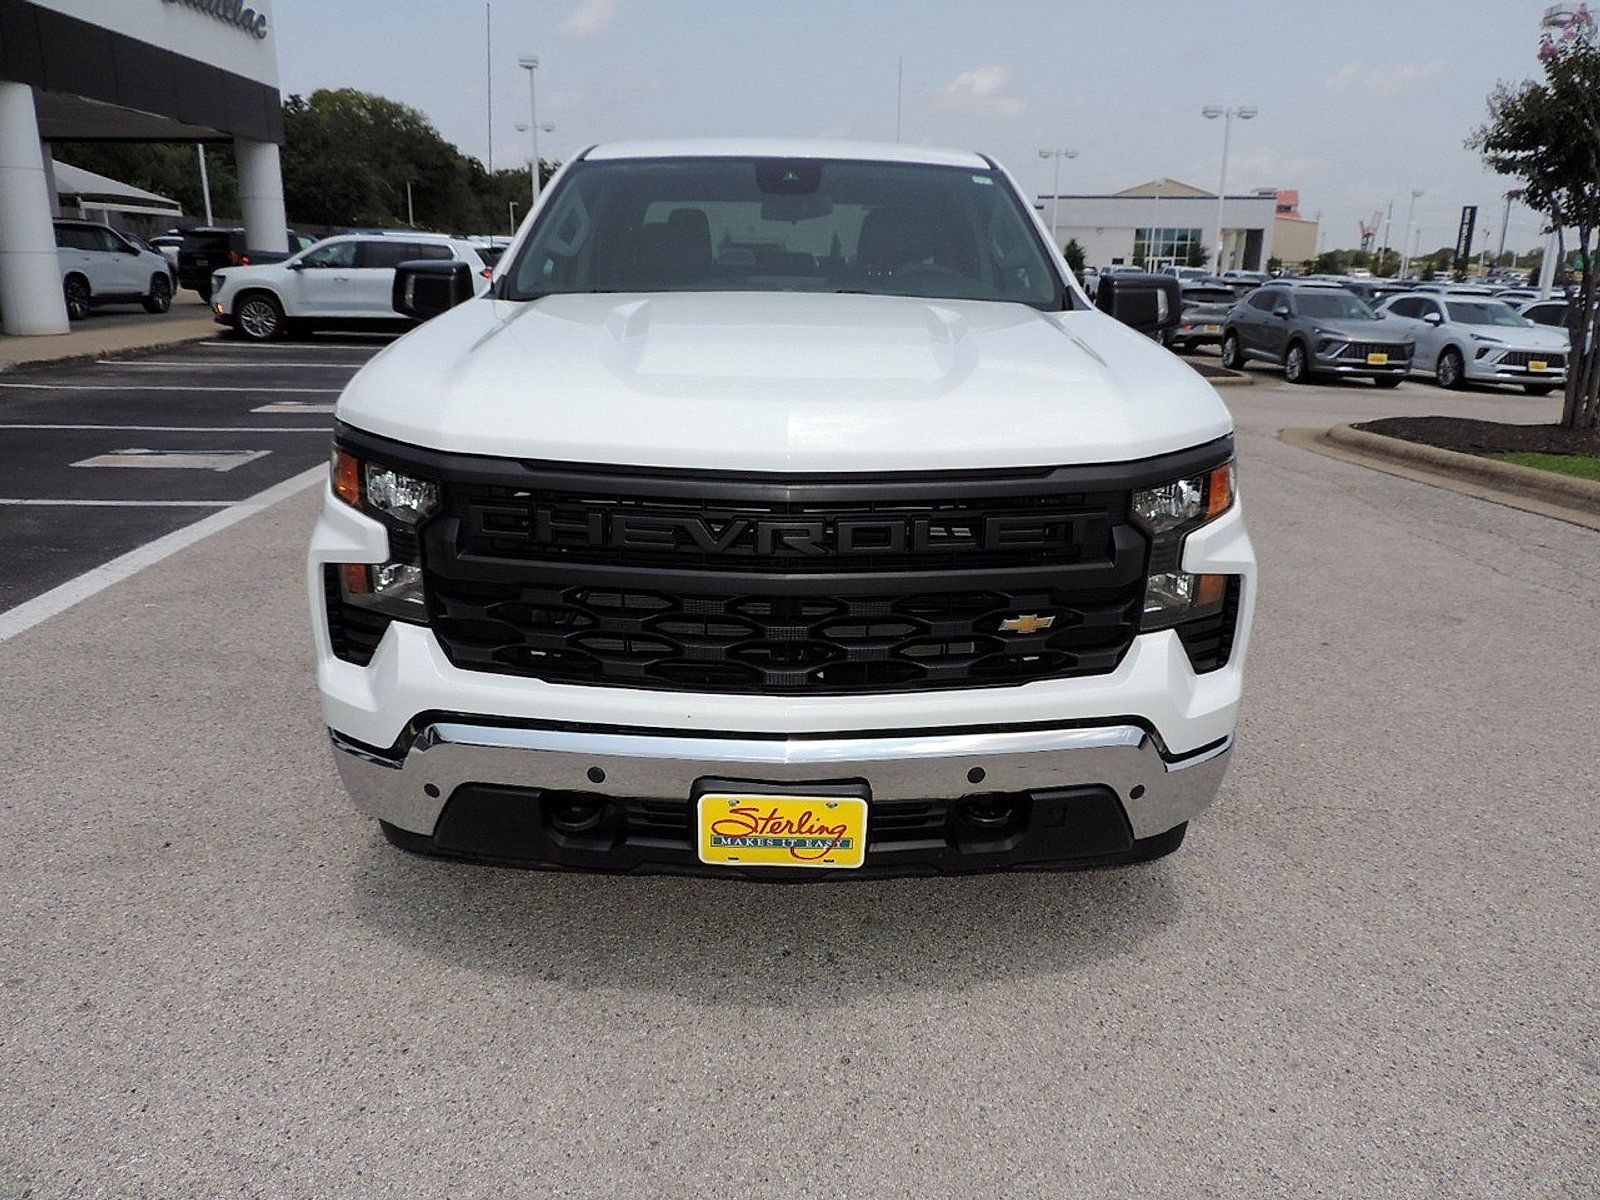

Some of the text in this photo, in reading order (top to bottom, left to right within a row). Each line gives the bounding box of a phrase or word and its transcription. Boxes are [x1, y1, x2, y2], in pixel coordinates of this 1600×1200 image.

[161, 0, 268, 40] illac
[469, 504, 1107, 556] CHEVROLET
[711, 807, 848, 860] Sterling
[720, 837, 844, 849] MAKES IT EASY
